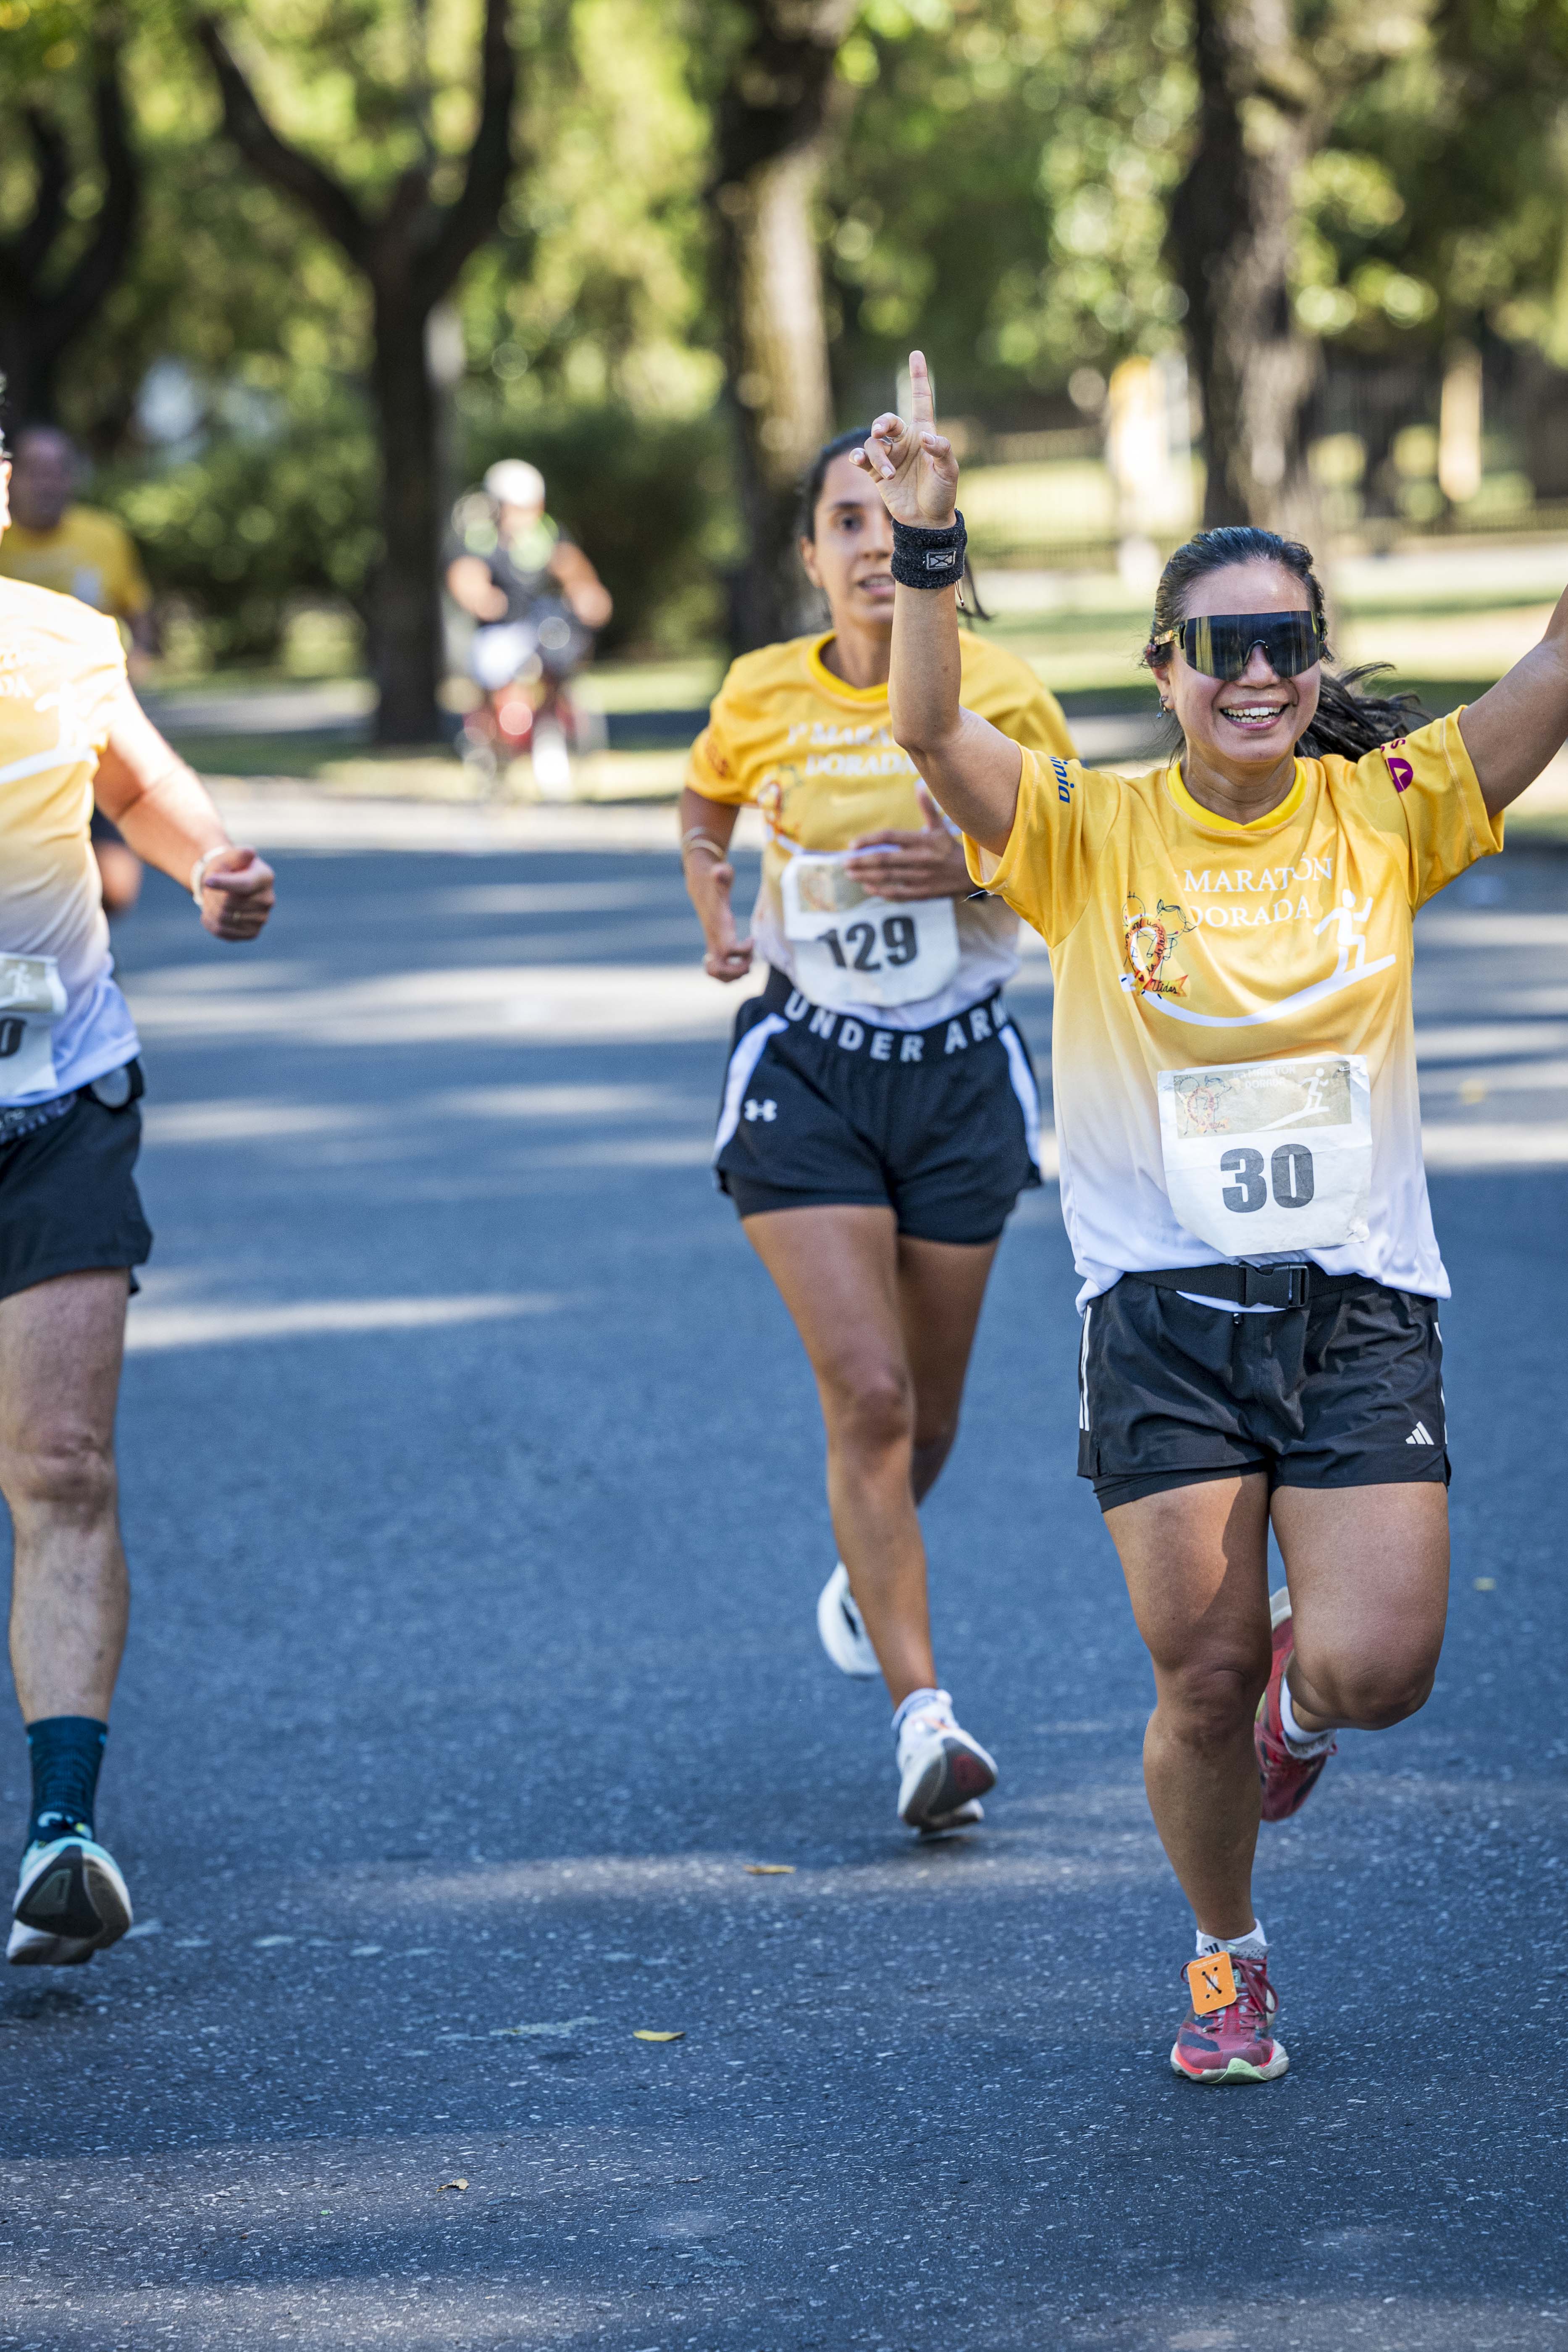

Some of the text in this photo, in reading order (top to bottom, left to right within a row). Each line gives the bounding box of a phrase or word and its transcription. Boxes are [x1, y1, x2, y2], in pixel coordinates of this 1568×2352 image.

[1183, 852, 1333, 892] MARATÓN
[817, 916, 918, 971] 129
[784, 990, 923, 1062] UNDER
[1221, 1144, 1314, 1213] 30
